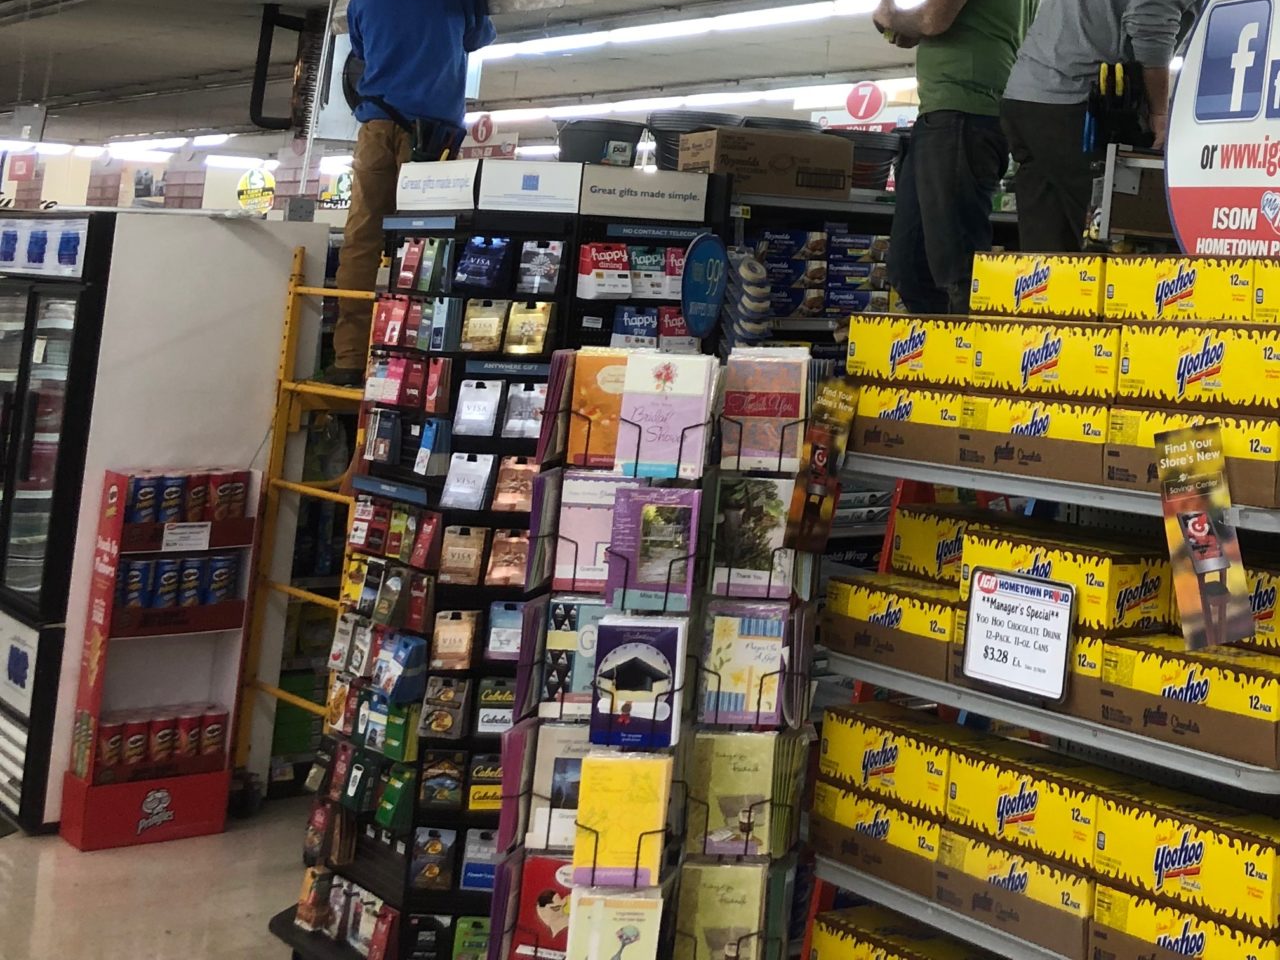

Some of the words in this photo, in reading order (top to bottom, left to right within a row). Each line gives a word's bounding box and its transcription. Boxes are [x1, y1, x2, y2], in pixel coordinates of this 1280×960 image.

[1230, 22, 1259, 112] f
[858, 86, 873, 117] 7
[477, 122, 487, 141] 6
[1200, 145, 1217, 170] or
[590, 185, 616, 195] Great
[619, 187, 638, 198] gifts
[640, 191, 665, 199] made
[668, 192, 700, 203] simple.
[1212, 207, 1257, 230] ISOM
[1196, 238, 1268, 255] HOMETOWN
[470, 257, 490, 266] VISA
[591, 248, 628, 262] happy
[631, 252, 666, 267] happy
[1079, 270, 1088, 281] 12
[1230, 274, 1239, 286] 12
[472, 322, 493, 330] VISA
[623, 313, 657, 327] happy
[665, 315, 686, 327] hap
[955, 336, 963, 348] 12
[1094, 345, 1102, 357] 12
[1263, 347, 1273, 360] 12
[466, 405, 488, 413] VISA
[941, 409, 948, 420] 12
[1083, 424, 1091, 435] 12
[1165, 442, 1187, 455] Find
[1190, 438, 1213, 450] Your
[1250, 439, 1260, 453] 12
[1160, 453, 1194, 469] Store's
[1197, 450, 1220, 462] New
[456, 477, 476, 485] VISA
[1169, 484, 1194, 495] Savings
[1195, 480, 1218, 489] Center
[451, 552, 472, 561] VISA
[980, 574, 996, 589] IGA
[999, 580, 1042, 597] HOMETOWN
[1085, 573, 1095, 587] 12
[930, 620, 937, 633] 12
[983, 645, 1009, 664] $3.28
[1078, 654, 1087, 667] 12
[481, 689, 514, 701] Cabela
[1249, 695, 1259, 710] 12
[1259, 705, 1272, 713] PACK
[926, 760, 934, 773] 12
[1071, 808, 1080, 822] 12
[918, 836, 926, 849] 12
[1244, 862, 1255, 877] 12
[1255, 870, 1268, 881] PACK
[1061, 892, 1070, 905] 12
